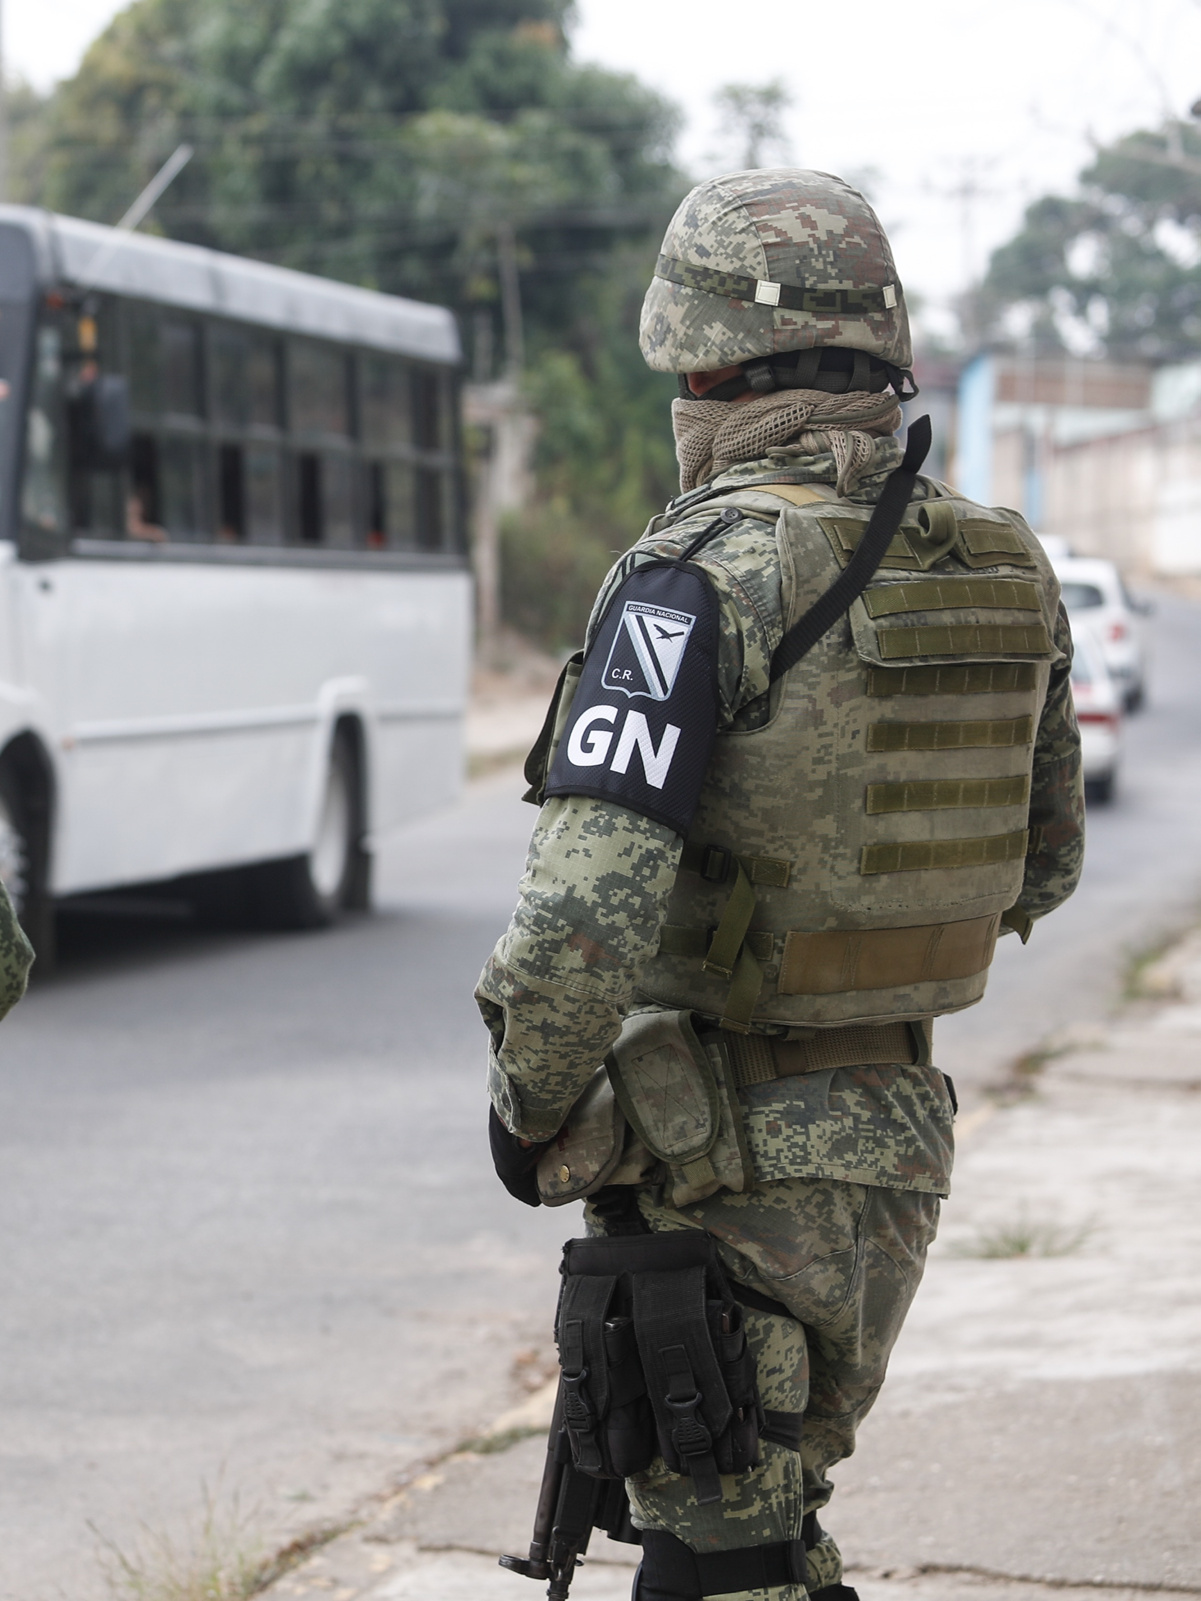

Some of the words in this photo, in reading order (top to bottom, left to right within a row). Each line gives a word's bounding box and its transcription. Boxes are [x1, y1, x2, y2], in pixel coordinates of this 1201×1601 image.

[628, 604, 656, 615] GUARDIA
[656, 610, 689, 624] NACIONAL
[611, 668, 634, 681] C.R.
[567, 704, 682, 790] GN
